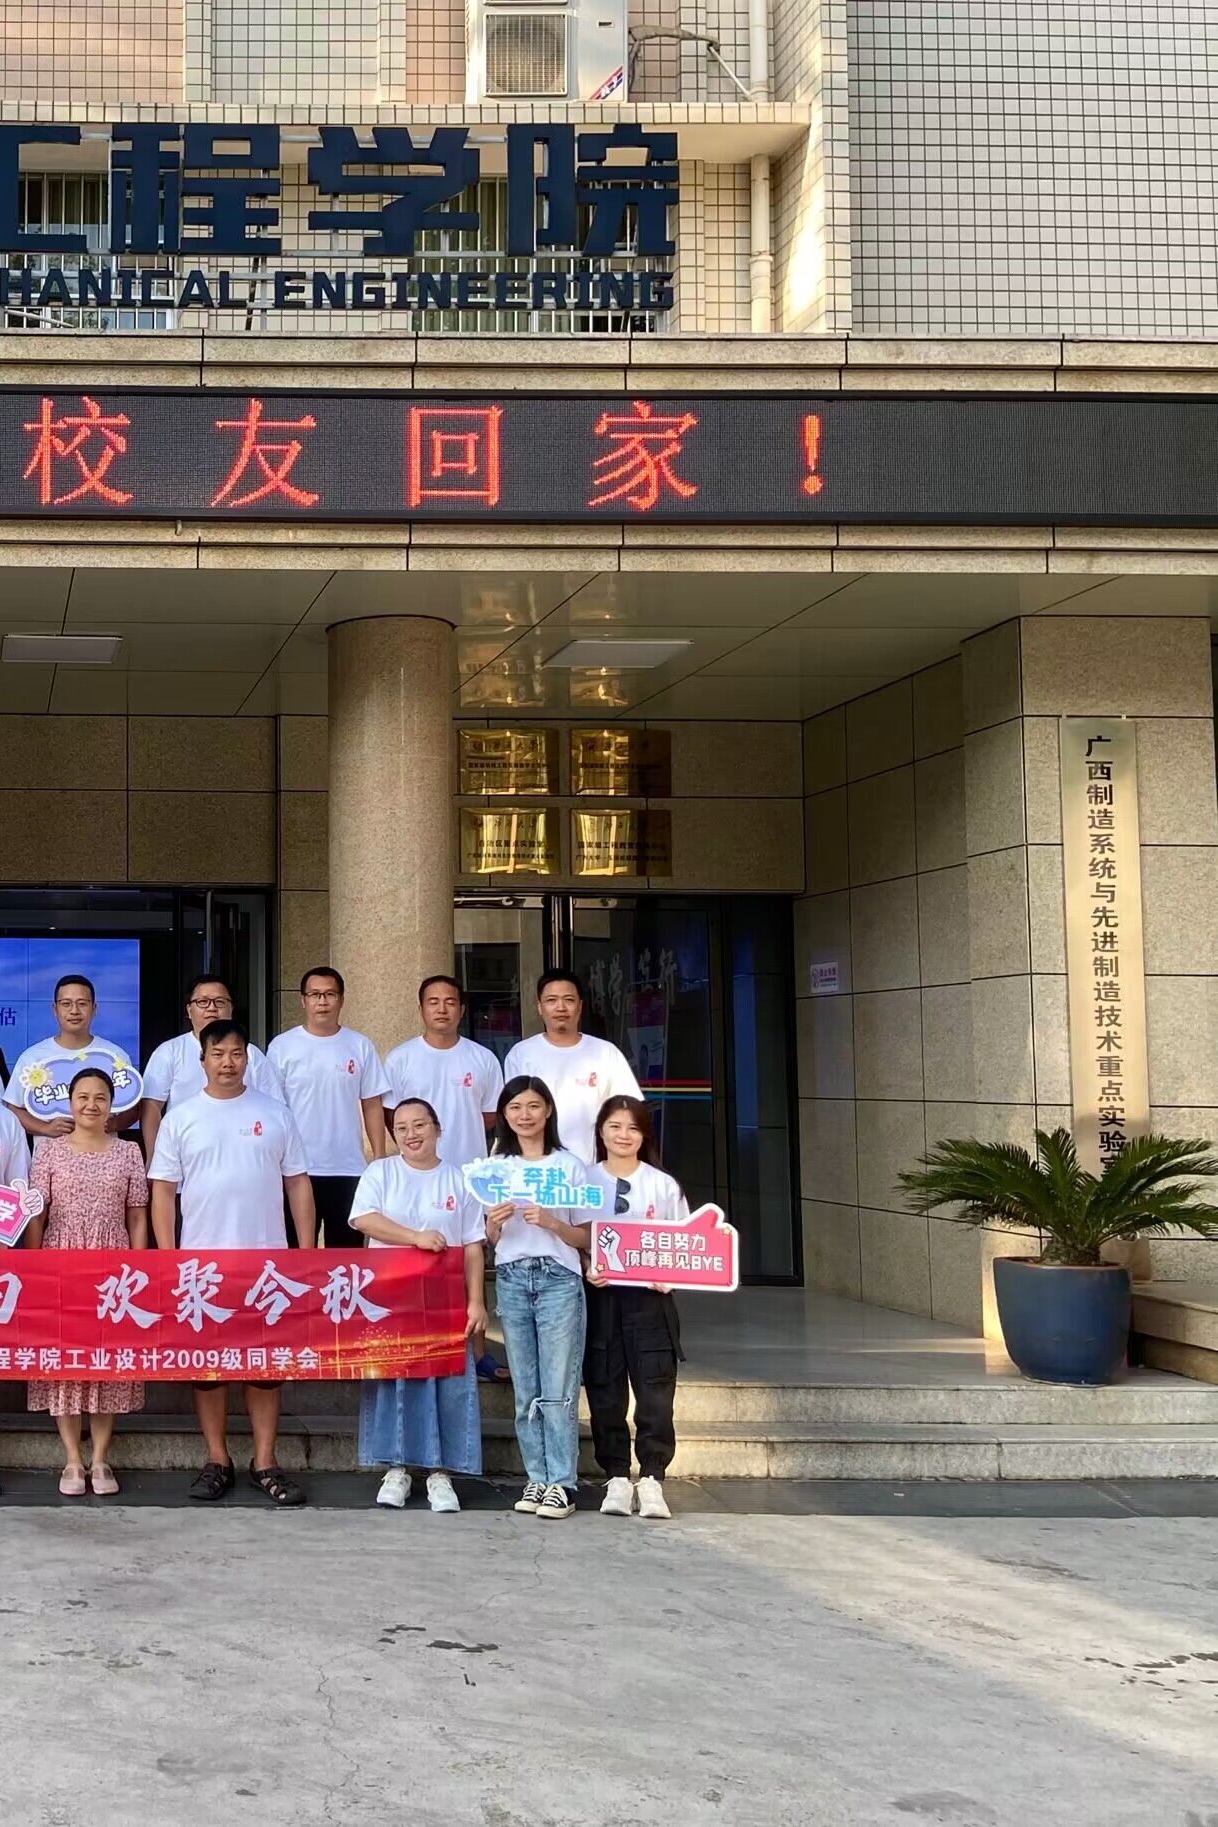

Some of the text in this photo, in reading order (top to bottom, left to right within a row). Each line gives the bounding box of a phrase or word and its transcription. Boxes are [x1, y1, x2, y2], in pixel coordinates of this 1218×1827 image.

[274, 270, 674, 311] ENGINEERING
[523, 1167, 567, 1188] 奔赴
[490, 1184, 602, 1207] 下一场山海
[640, 1230, 707, 1252] 各自努力
[624, 1249, 724, 1272] 顶峰再见BYE
[94, 1257, 393, 1333] 欢聚今秋
